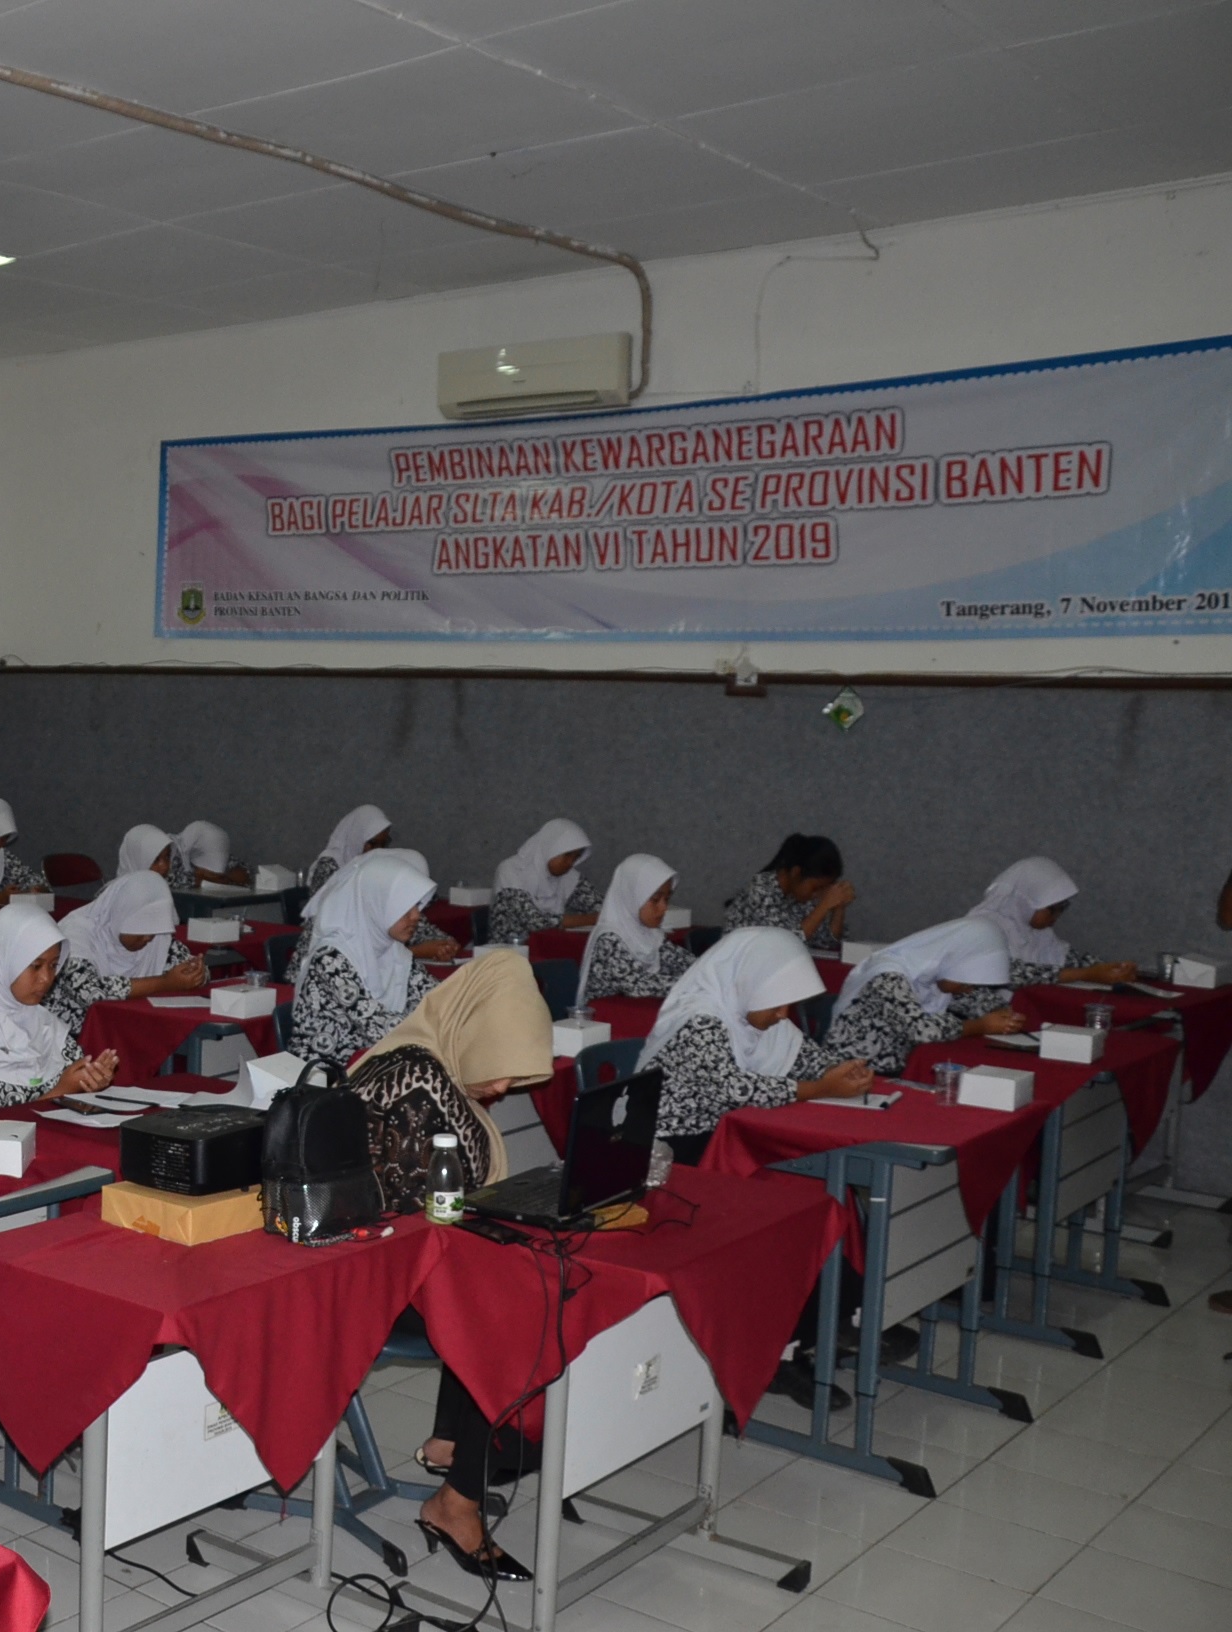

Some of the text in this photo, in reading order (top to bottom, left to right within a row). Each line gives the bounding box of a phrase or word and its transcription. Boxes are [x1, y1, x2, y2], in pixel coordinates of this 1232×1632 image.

[394, 414, 898, 484] PEMBINAAN KEWARGANEGARAAN
[270, 498, 323, 533] BAGI
[331, 492, 445, 530] PELAJAR
[452, 489, 518, 525] SLTA
[706, 475, 749, 513] SE
[759, 462, 930, 510] PROVINSI
[945, 447, 1104, 500] BANTEN
[437, 520, 832, 571] ANGKATAN VI TAHUN 2019
[213, 589, 430, 601] BADAN KESATUAN BANGSA DAN POLITIK
[213, 605, 301, 617] PROVINSI BANTEN
[939, 600, 1052, 620] Tangerang,
[1059, 597, 1072, 615] 7
[1079, 594, 1188, 614] November
